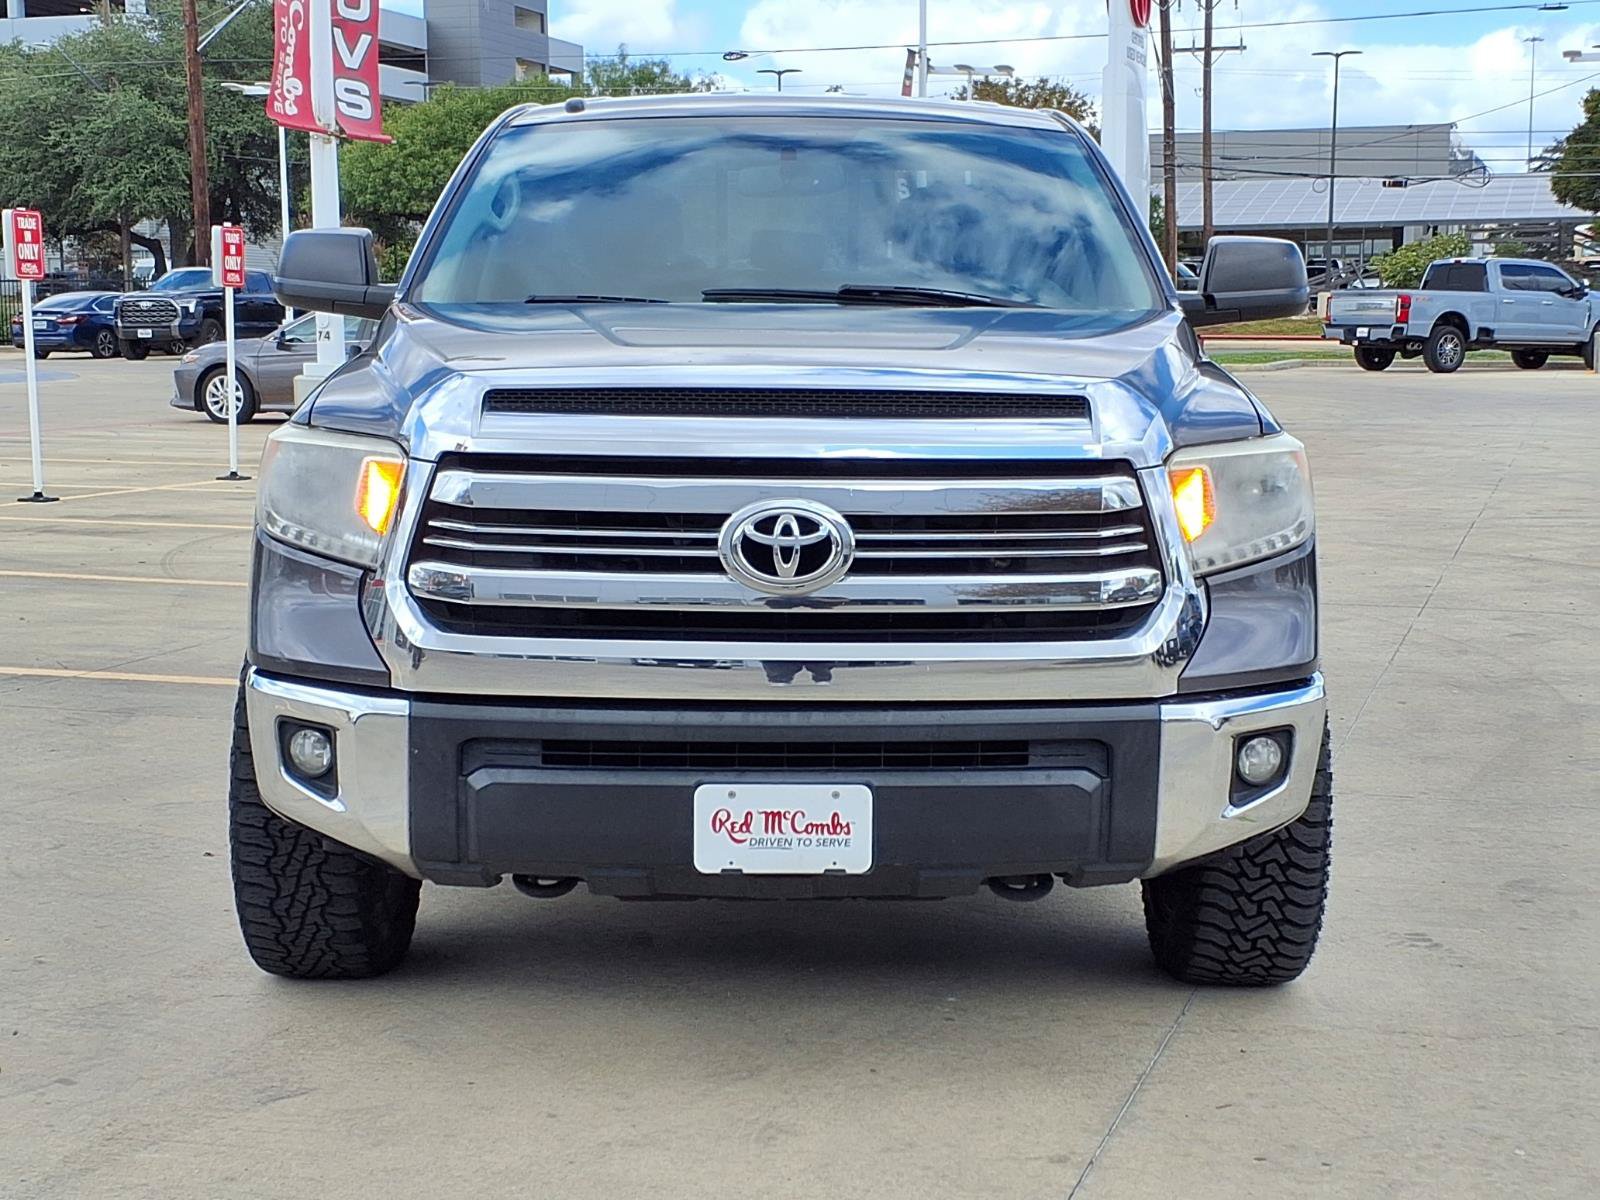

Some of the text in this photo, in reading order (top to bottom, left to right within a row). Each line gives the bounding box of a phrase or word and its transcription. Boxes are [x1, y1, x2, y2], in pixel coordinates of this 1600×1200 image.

[282, 0, 304, 116] Combs
[273, 51, 285, 115] SERVE
[17, 216, 38, 230] TRADE
[224, 232, 240, 244] TRADE
[18, 243, 39, 260] ONLY
[224, 255, 241, 270] ONLY
[711, 808, 753, 844] Red
[749, 837, 851, 848] DRIVEN TO SERVE
